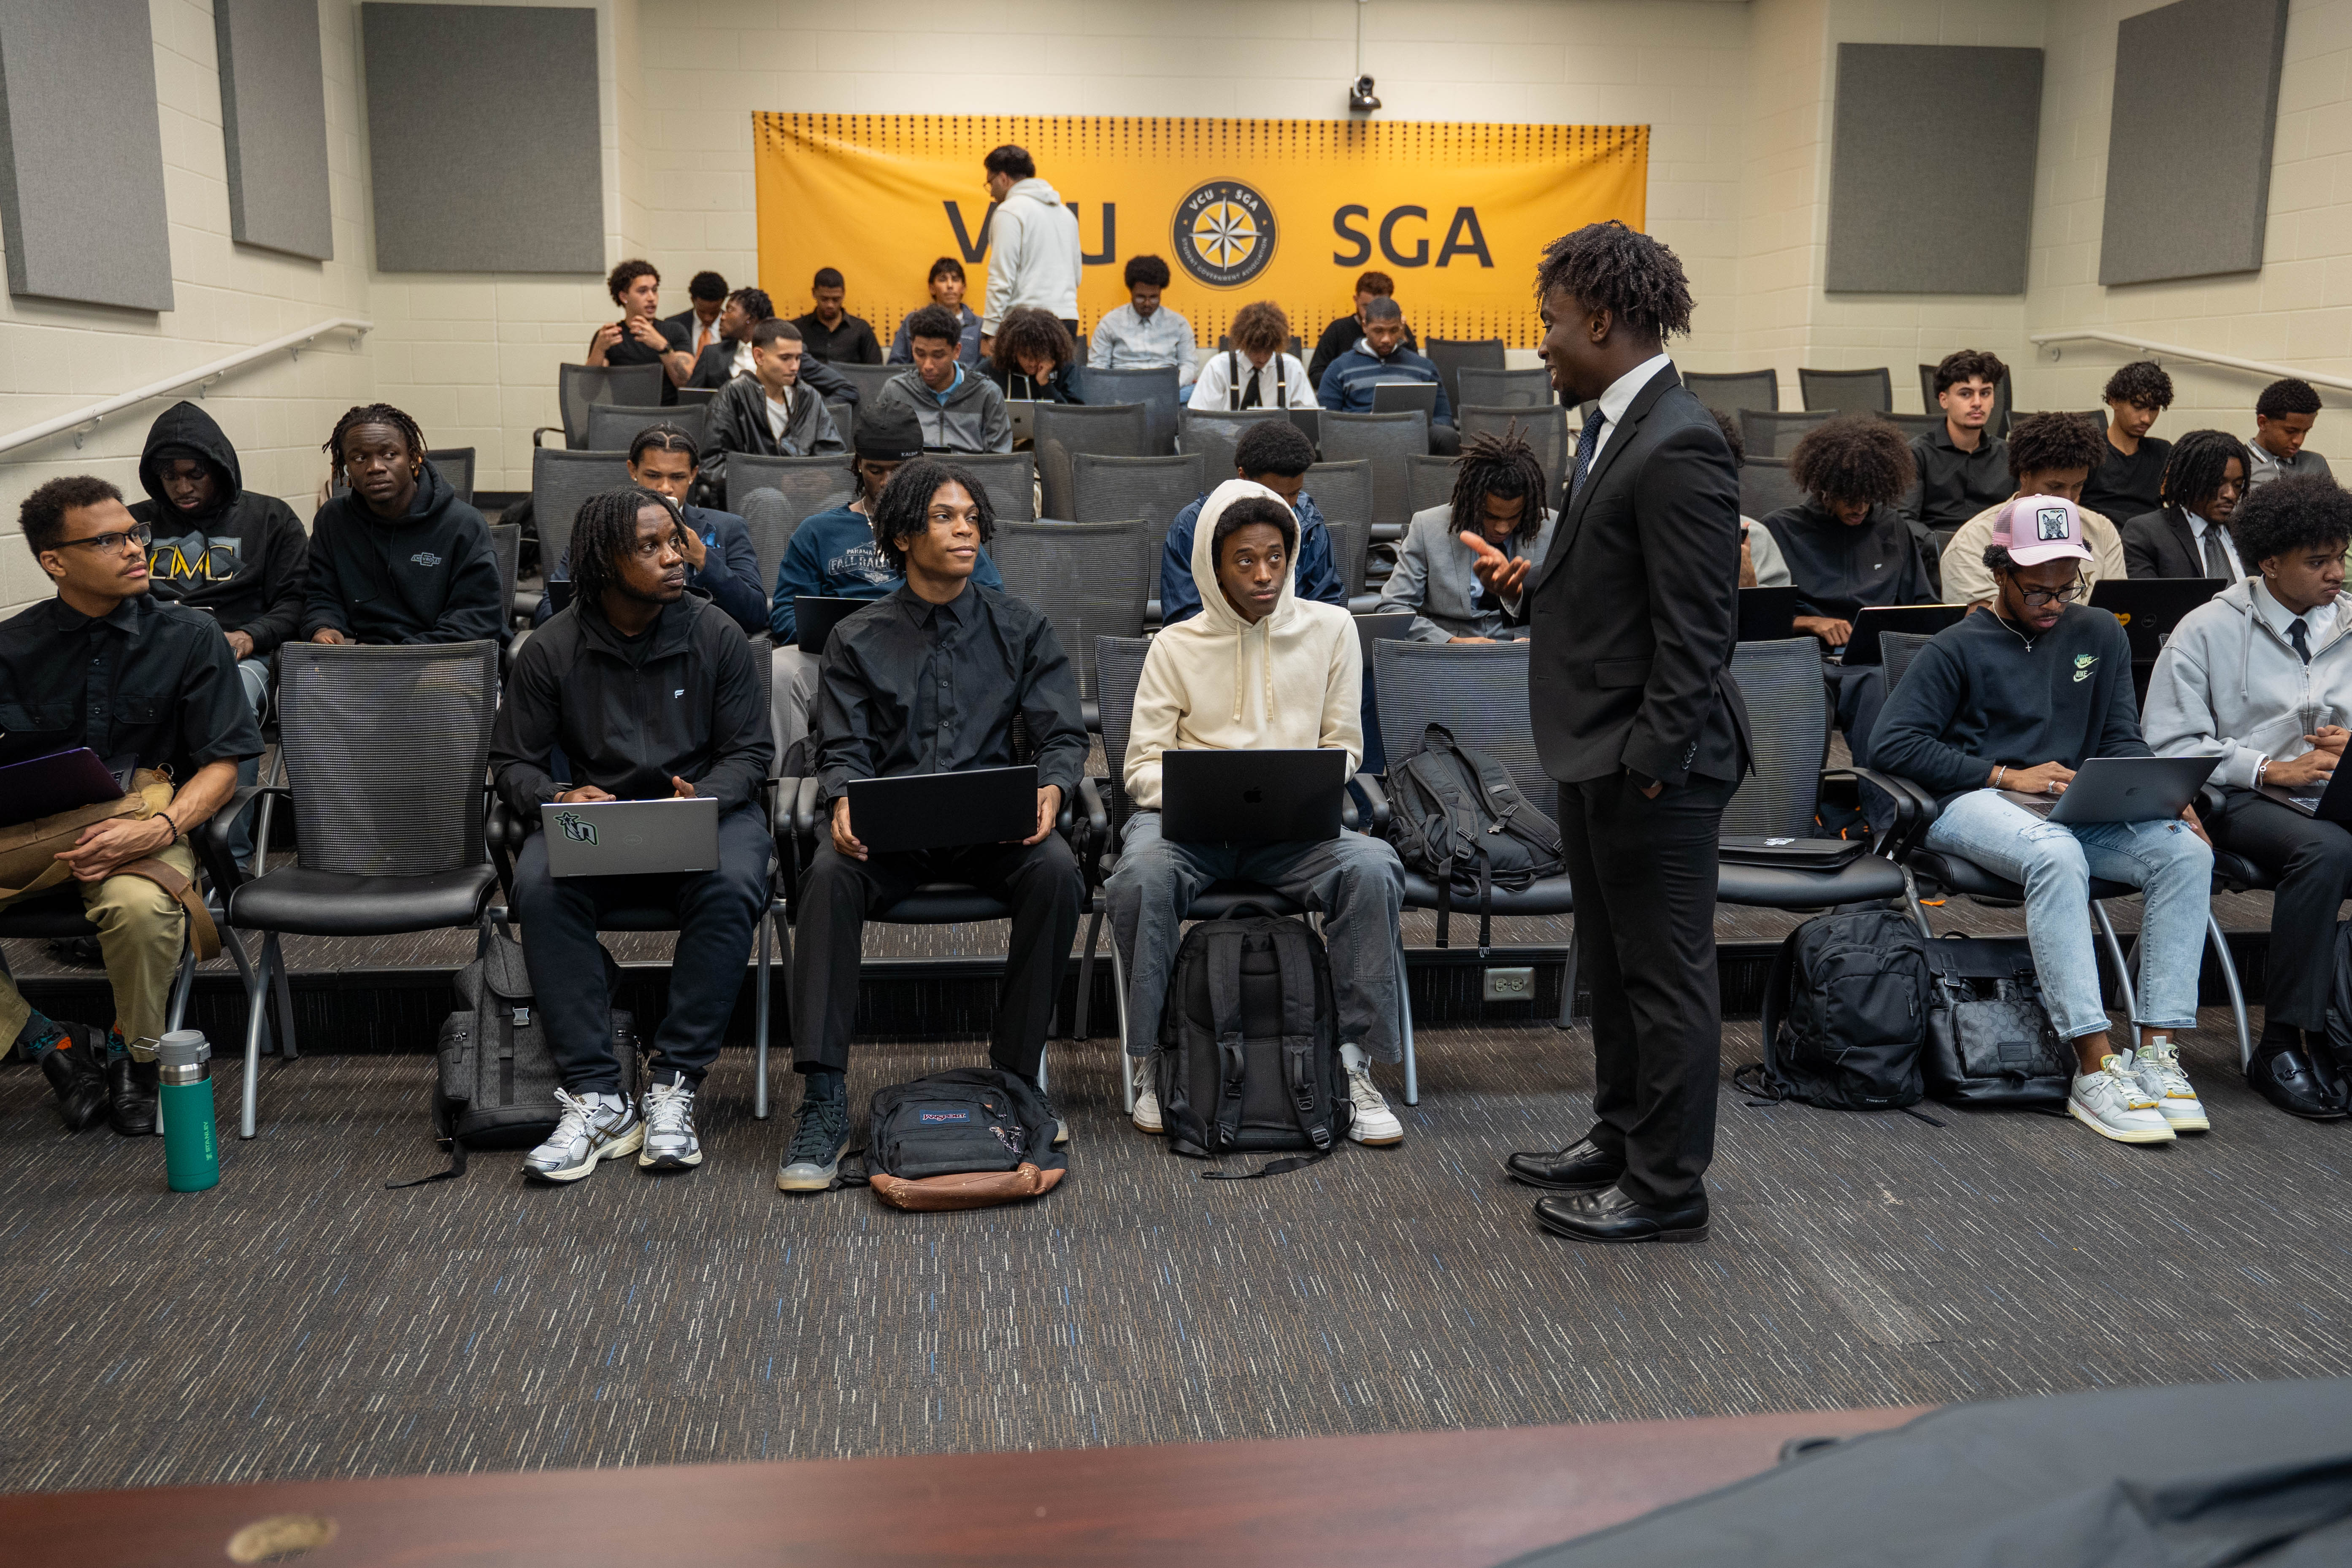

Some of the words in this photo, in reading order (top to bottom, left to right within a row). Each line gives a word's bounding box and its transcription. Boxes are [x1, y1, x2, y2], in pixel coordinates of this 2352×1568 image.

[1189, 189, 1214, 210] VCU
[1235, 189, 1259, 211] SGA
[943, 201, 1116, 265] VU
[1333, 204, 1494, 268] SGA
[1182, 237, 1198, 267] STUDENT
[1197, 265, 1241, 281] GOVERNMENT
[1242, 236, 1268, 277] ASSOCIATION
[831, 556, 857, 570] FALL
[2079, 656, 2092, 664] NIKE
